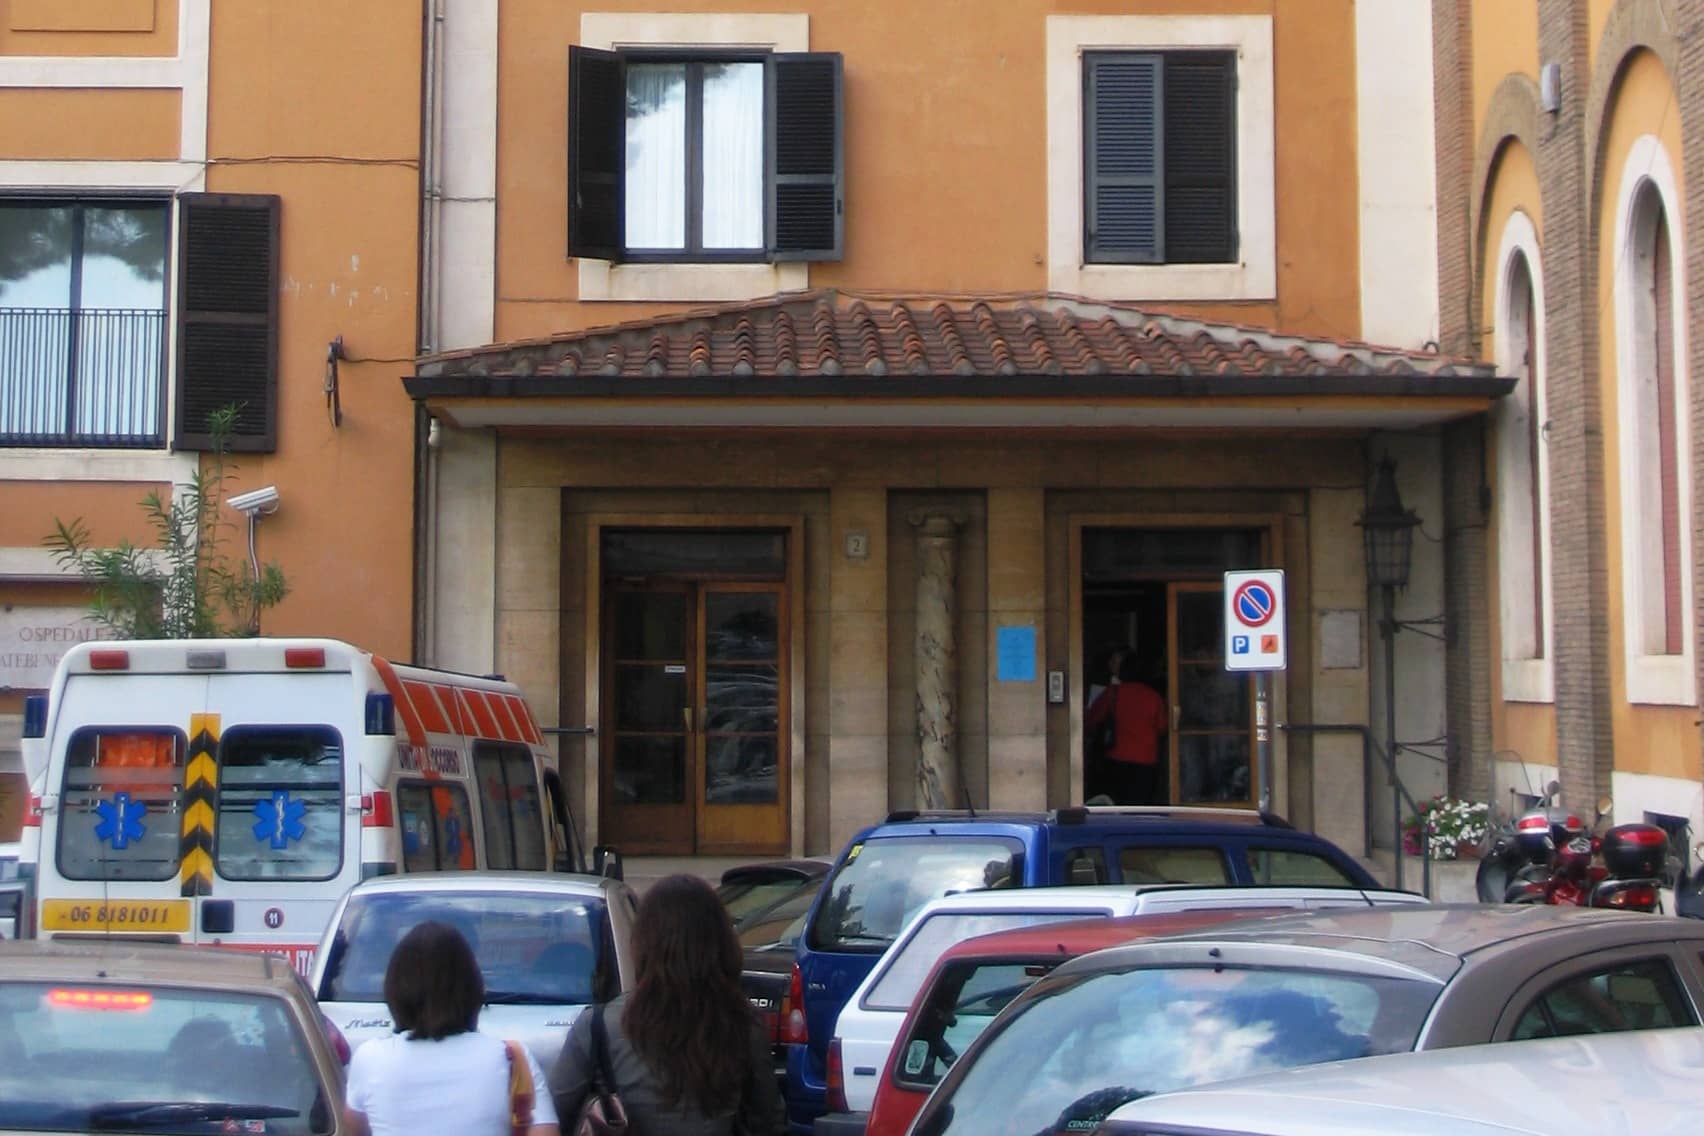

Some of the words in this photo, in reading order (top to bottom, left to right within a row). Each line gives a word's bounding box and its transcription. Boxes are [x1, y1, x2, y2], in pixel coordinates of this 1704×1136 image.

[1235, 638, 1246, 652] P
[70, 906, 91, 923] 06
[97, 906, 169, 924] 8181011
[269, 912, 278, 925] 11
